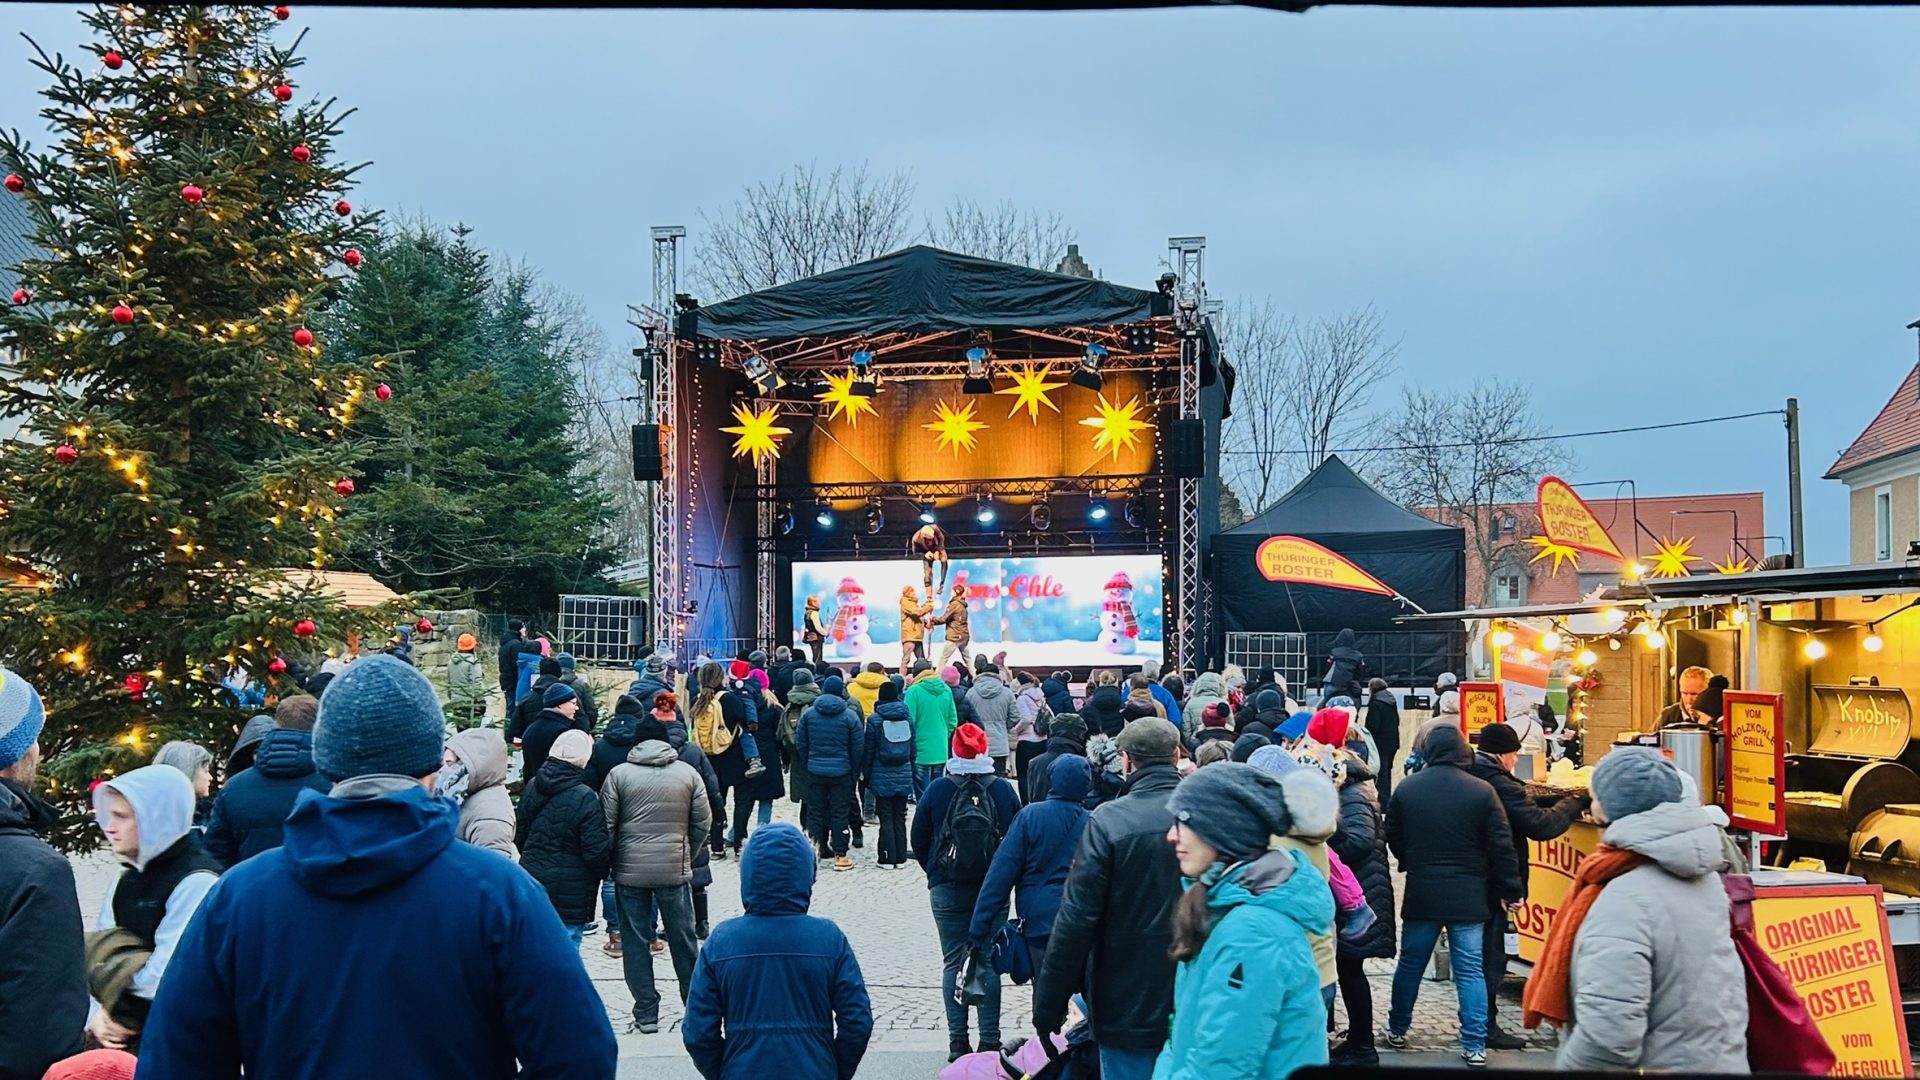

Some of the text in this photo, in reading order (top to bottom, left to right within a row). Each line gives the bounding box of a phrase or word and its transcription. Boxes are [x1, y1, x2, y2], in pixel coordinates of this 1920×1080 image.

[1265, 552, 1336, 567] THÜRINGER
[1272, 564, 1334, 579] ROSTER
[1010, 576, 1064, 598] Ohle
[1744, 708, 1762, 719] VOM
[1731, 722, 1775, 746] HOLZKOHLE
[1743, 735, 1764, 747] GRILL
[1765, 906, 1861, 950] ORIGINAL
[1779, 938, 1882, 984] HÜRINGER
[1807, 979, 1876, 1018] OSTER
[1841, 1032, 1873, 1048] vom
[1831, 1058, 1902, 1078] HLEGRILL
